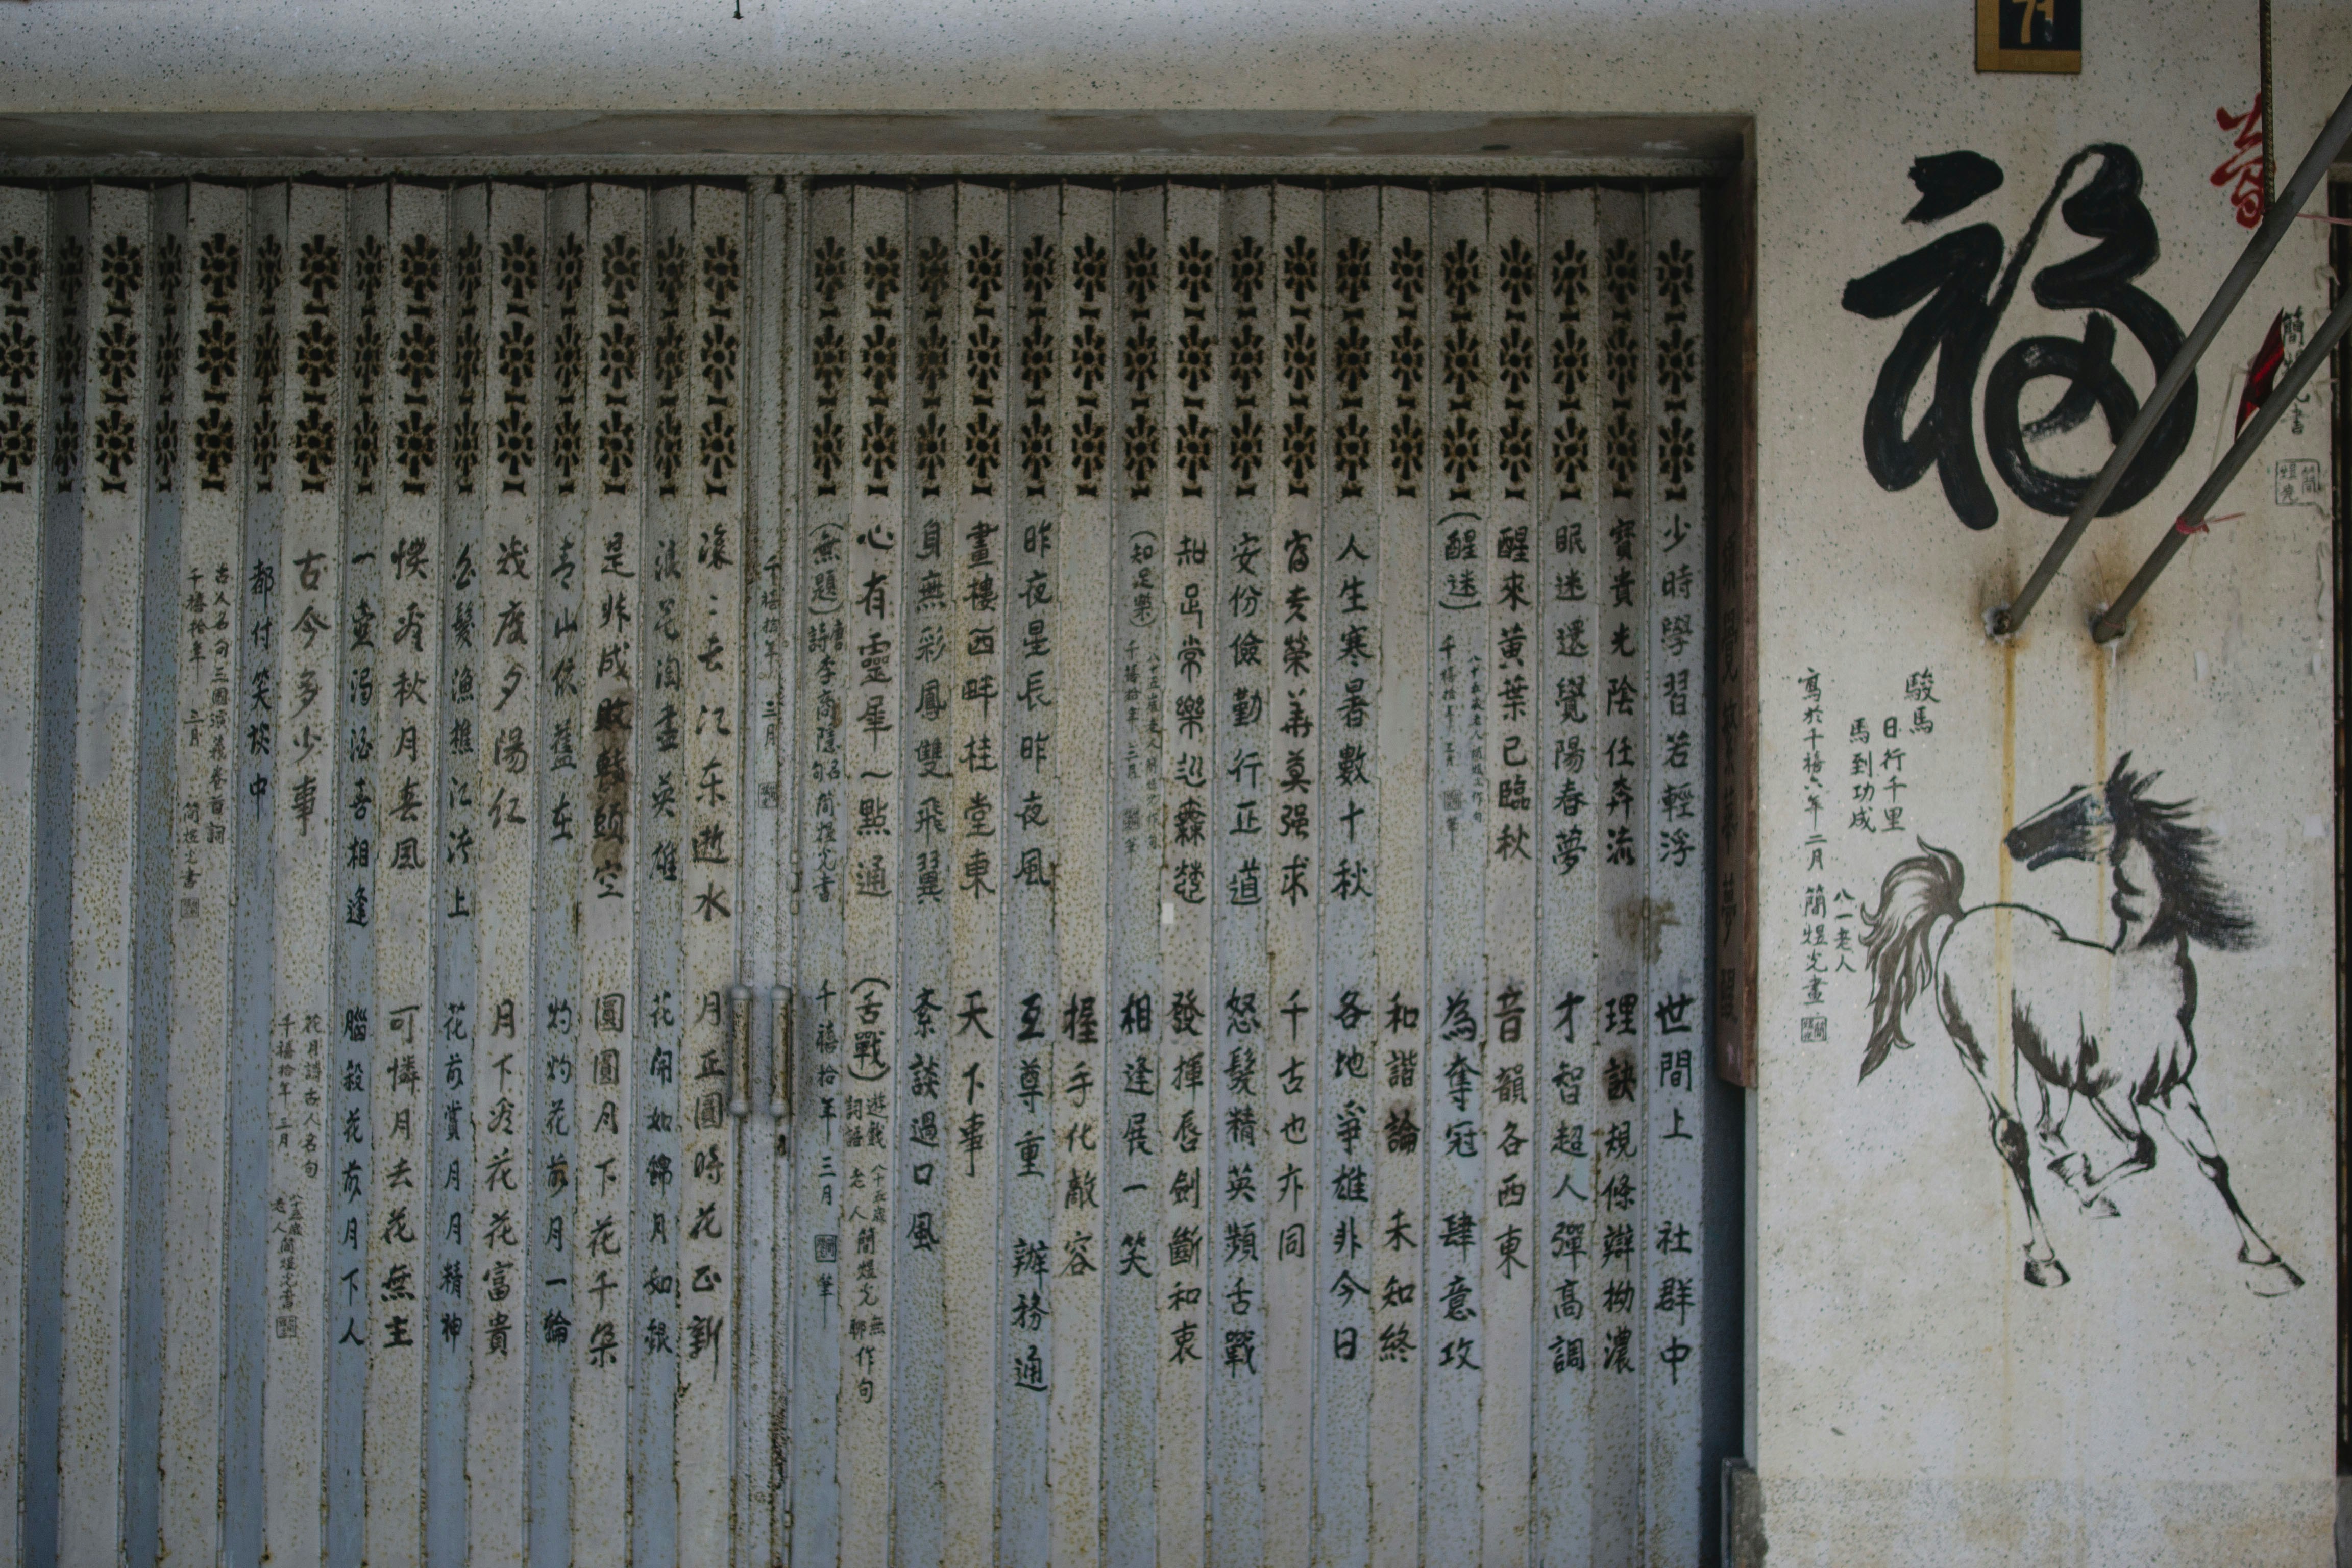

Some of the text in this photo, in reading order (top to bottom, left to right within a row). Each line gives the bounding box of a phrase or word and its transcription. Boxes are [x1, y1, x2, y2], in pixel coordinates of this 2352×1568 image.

[1842, 142, 2198, 530] 福
[290, 548, 331, 837] 古今多少事
[855, 524, 894, 897] 心有靈犀一點通
[914, 518, 946, 904] 身無彩鳳雙飛翼
[959, 520, 999, 900] 畫樓西畔桂堂東
[1848, 717, 1877, 833] 馬到功成
[1879, 716, 1907, 832] 日行千里
[1904, 666, 1941, 734] 駿馬
[1833, 888, 1857, 973] 八一老人
[953, 989, 995, 1178] 天下事
[1119, 991, 1155, 1278] 相逢展一笑
[1654, 993, 1697, 1386] 世間上 社群中
